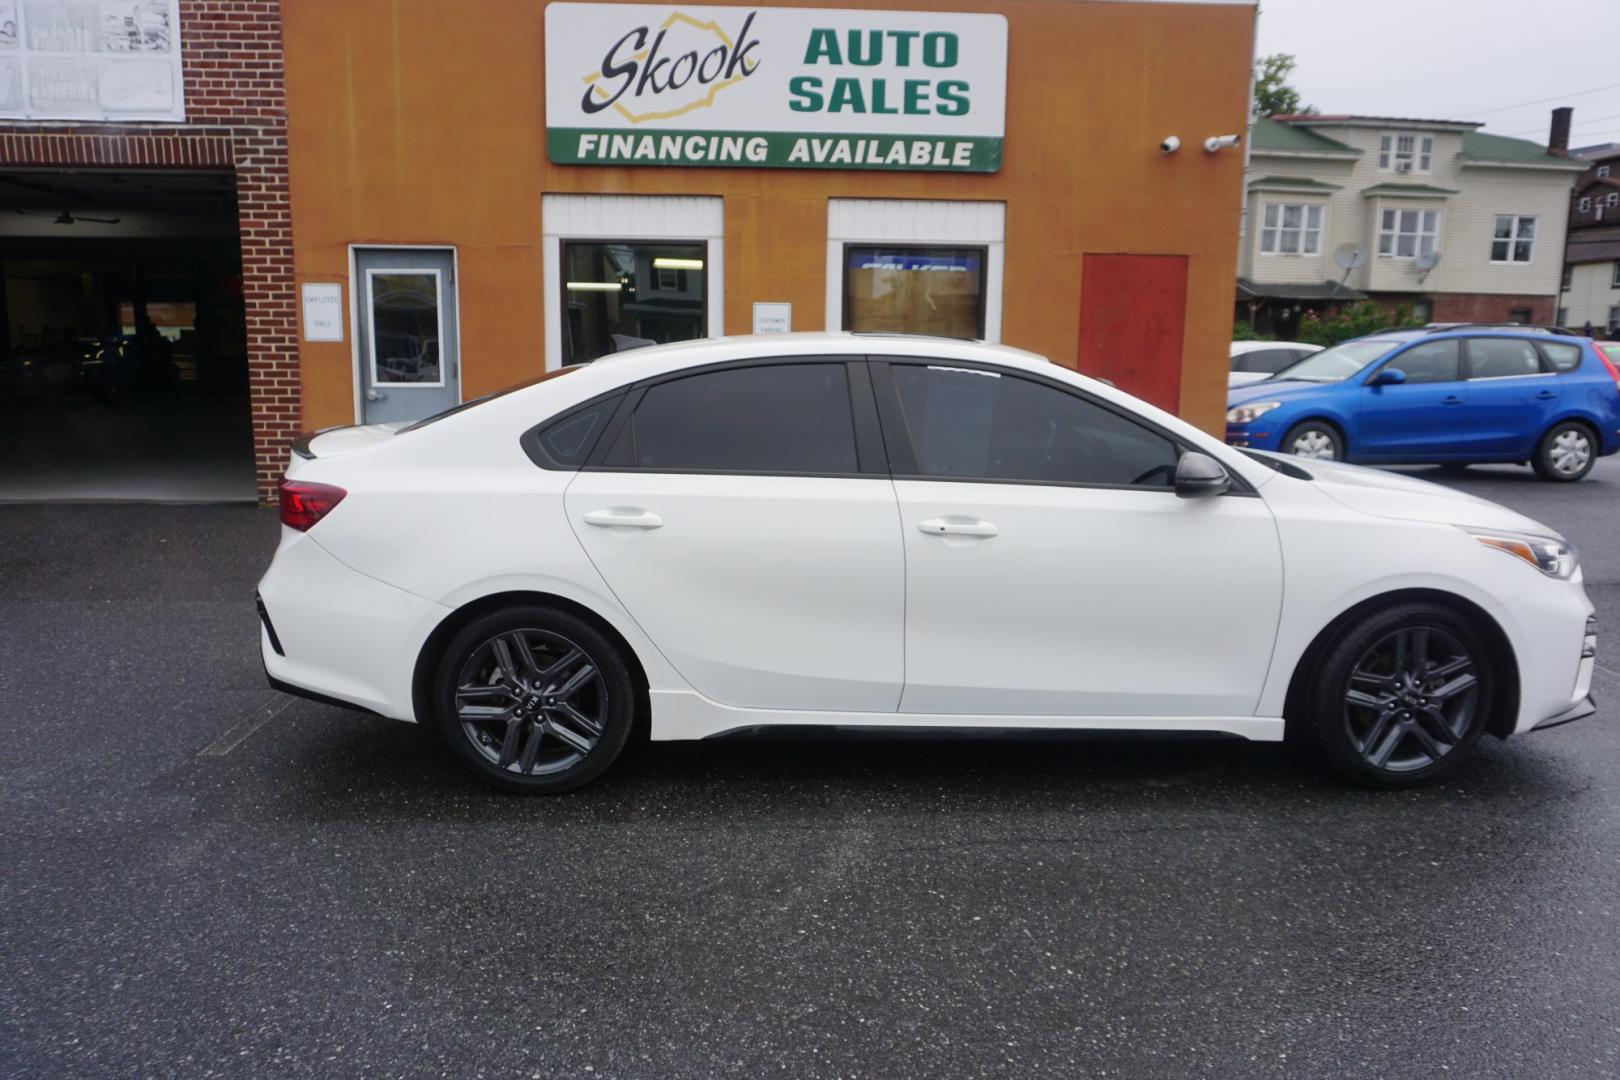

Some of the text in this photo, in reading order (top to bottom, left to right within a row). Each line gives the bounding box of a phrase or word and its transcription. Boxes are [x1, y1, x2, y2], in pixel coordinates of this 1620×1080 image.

[581, 11, 761, 114] Skook
[803, 28, 959, 68] AUTO
[789, 76, 971, 116] SALES
[577, 134, 974, 166] FINANCING AVAILABLE
